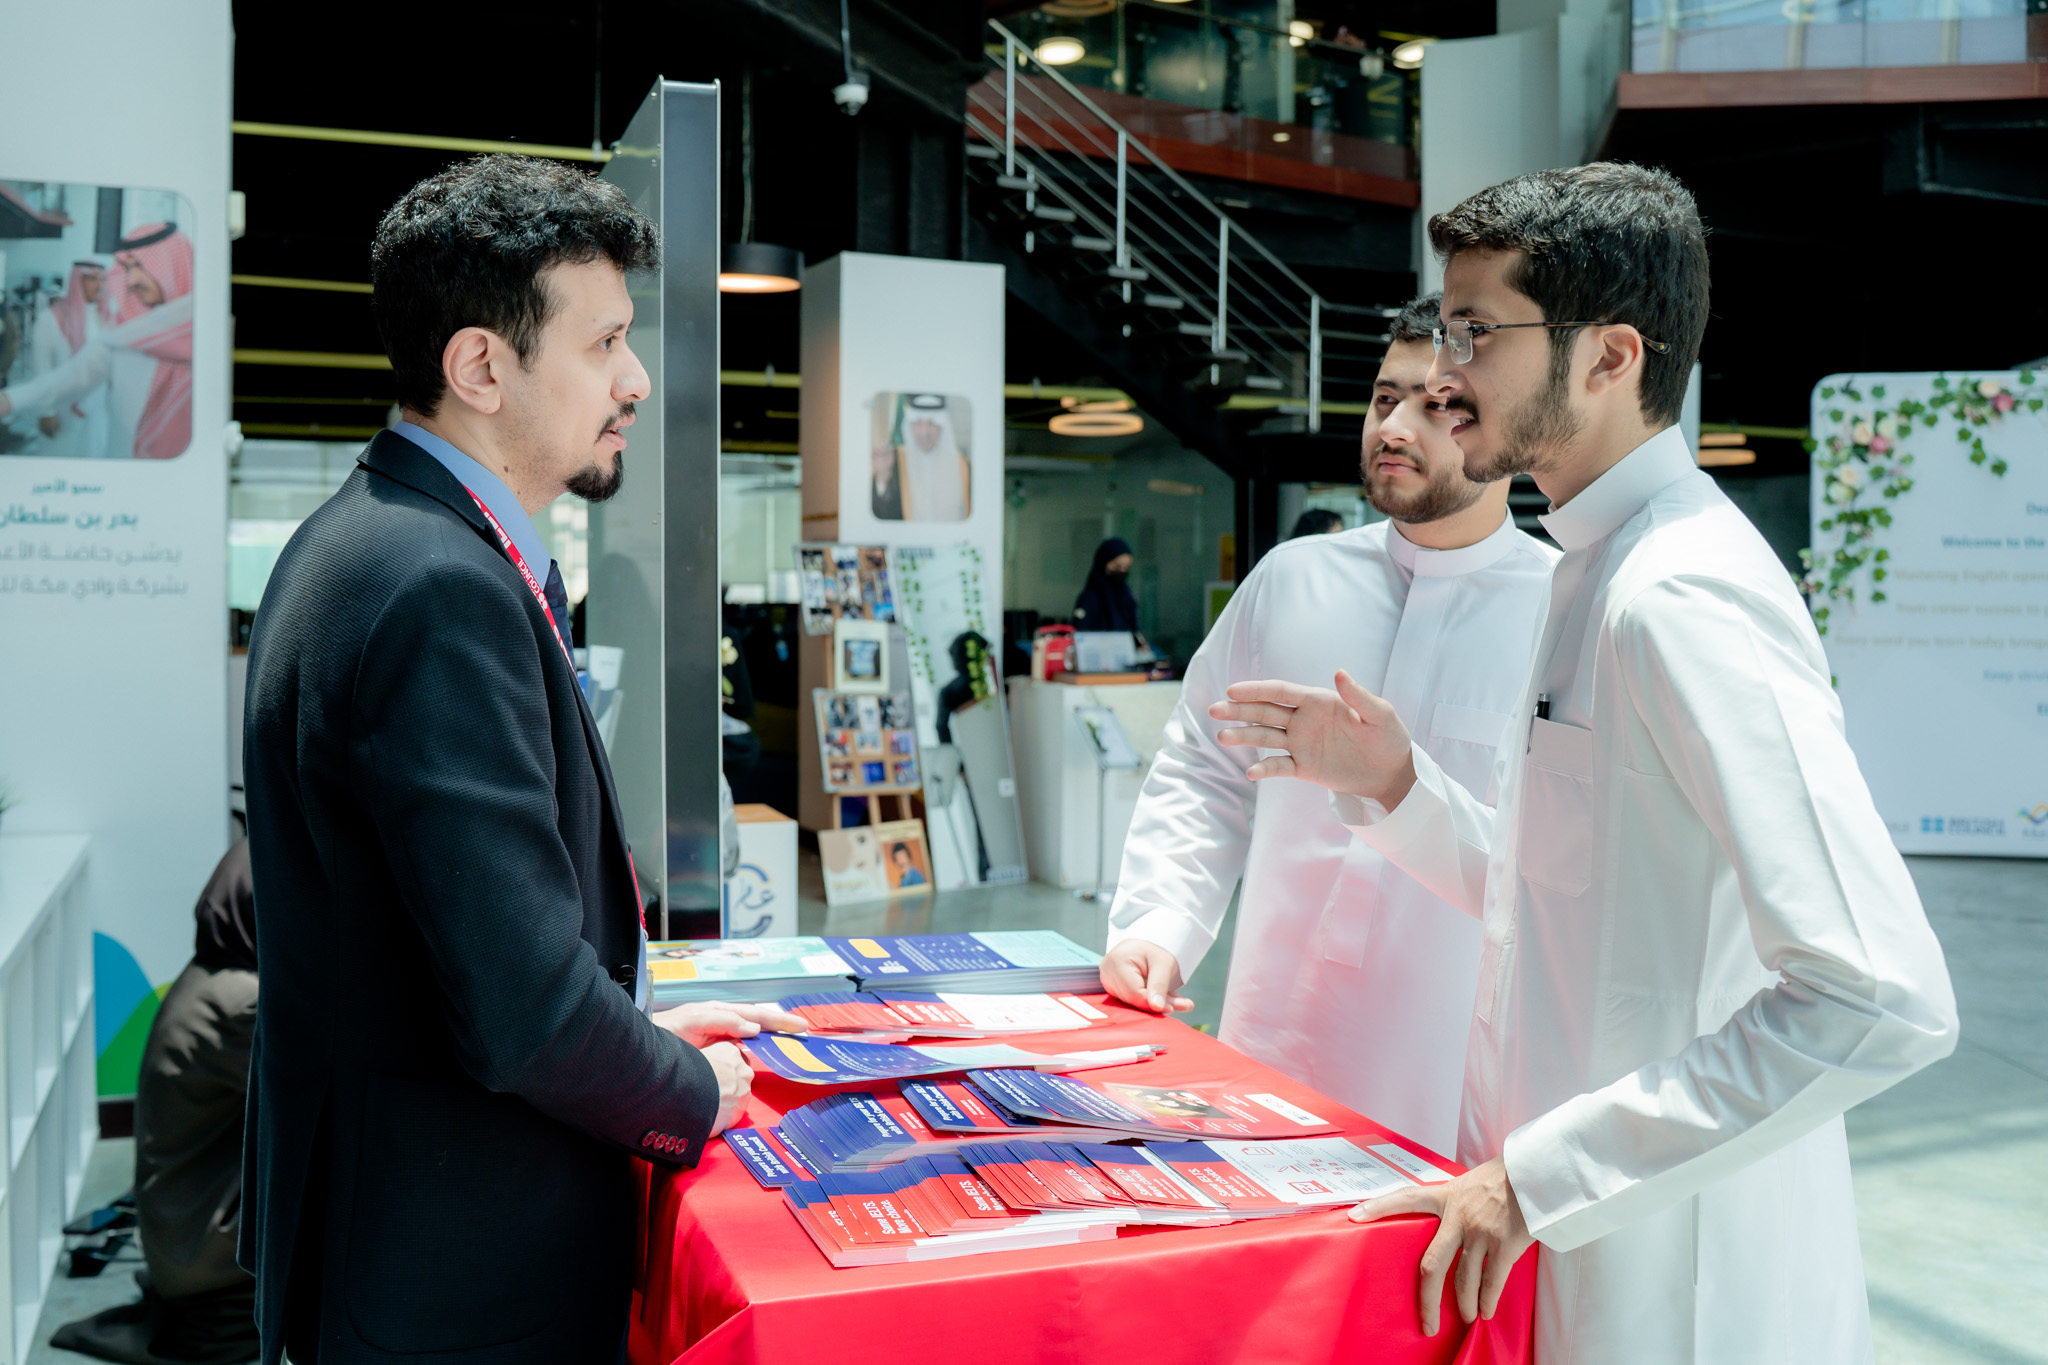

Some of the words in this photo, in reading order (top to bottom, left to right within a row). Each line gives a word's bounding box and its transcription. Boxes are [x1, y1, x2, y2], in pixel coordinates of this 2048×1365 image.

[75, 512, 102, 530] بن
[106, 512, 139, 531] بدر
[1941, 536, 2002, 548] Welcome
[2024, 536, 2045, 548] the
[517, 557, 541, 595] COUNCIL
[877, 1113, 895, 1125] British
[732, 1134, 749, 1146] IELTS
[748, 1136, 768, 1151] Council
[762, 1151, 780, 1164] British
[758, 1161, 777, 1177] Prepare
[773, 1164, 789, 1173] with
[959, 1180, 979, 1195] IELTS.
[1208, 1182, 1231, 1196] Same
[862, 1200, 883, 1217] IELTS.
[880, 1199, 900, 1218] choice.
[973, 1196, 991, 1210] Same
[877, 1218, 895, 1234] Same
[894, 1219, 912, 1233] More
